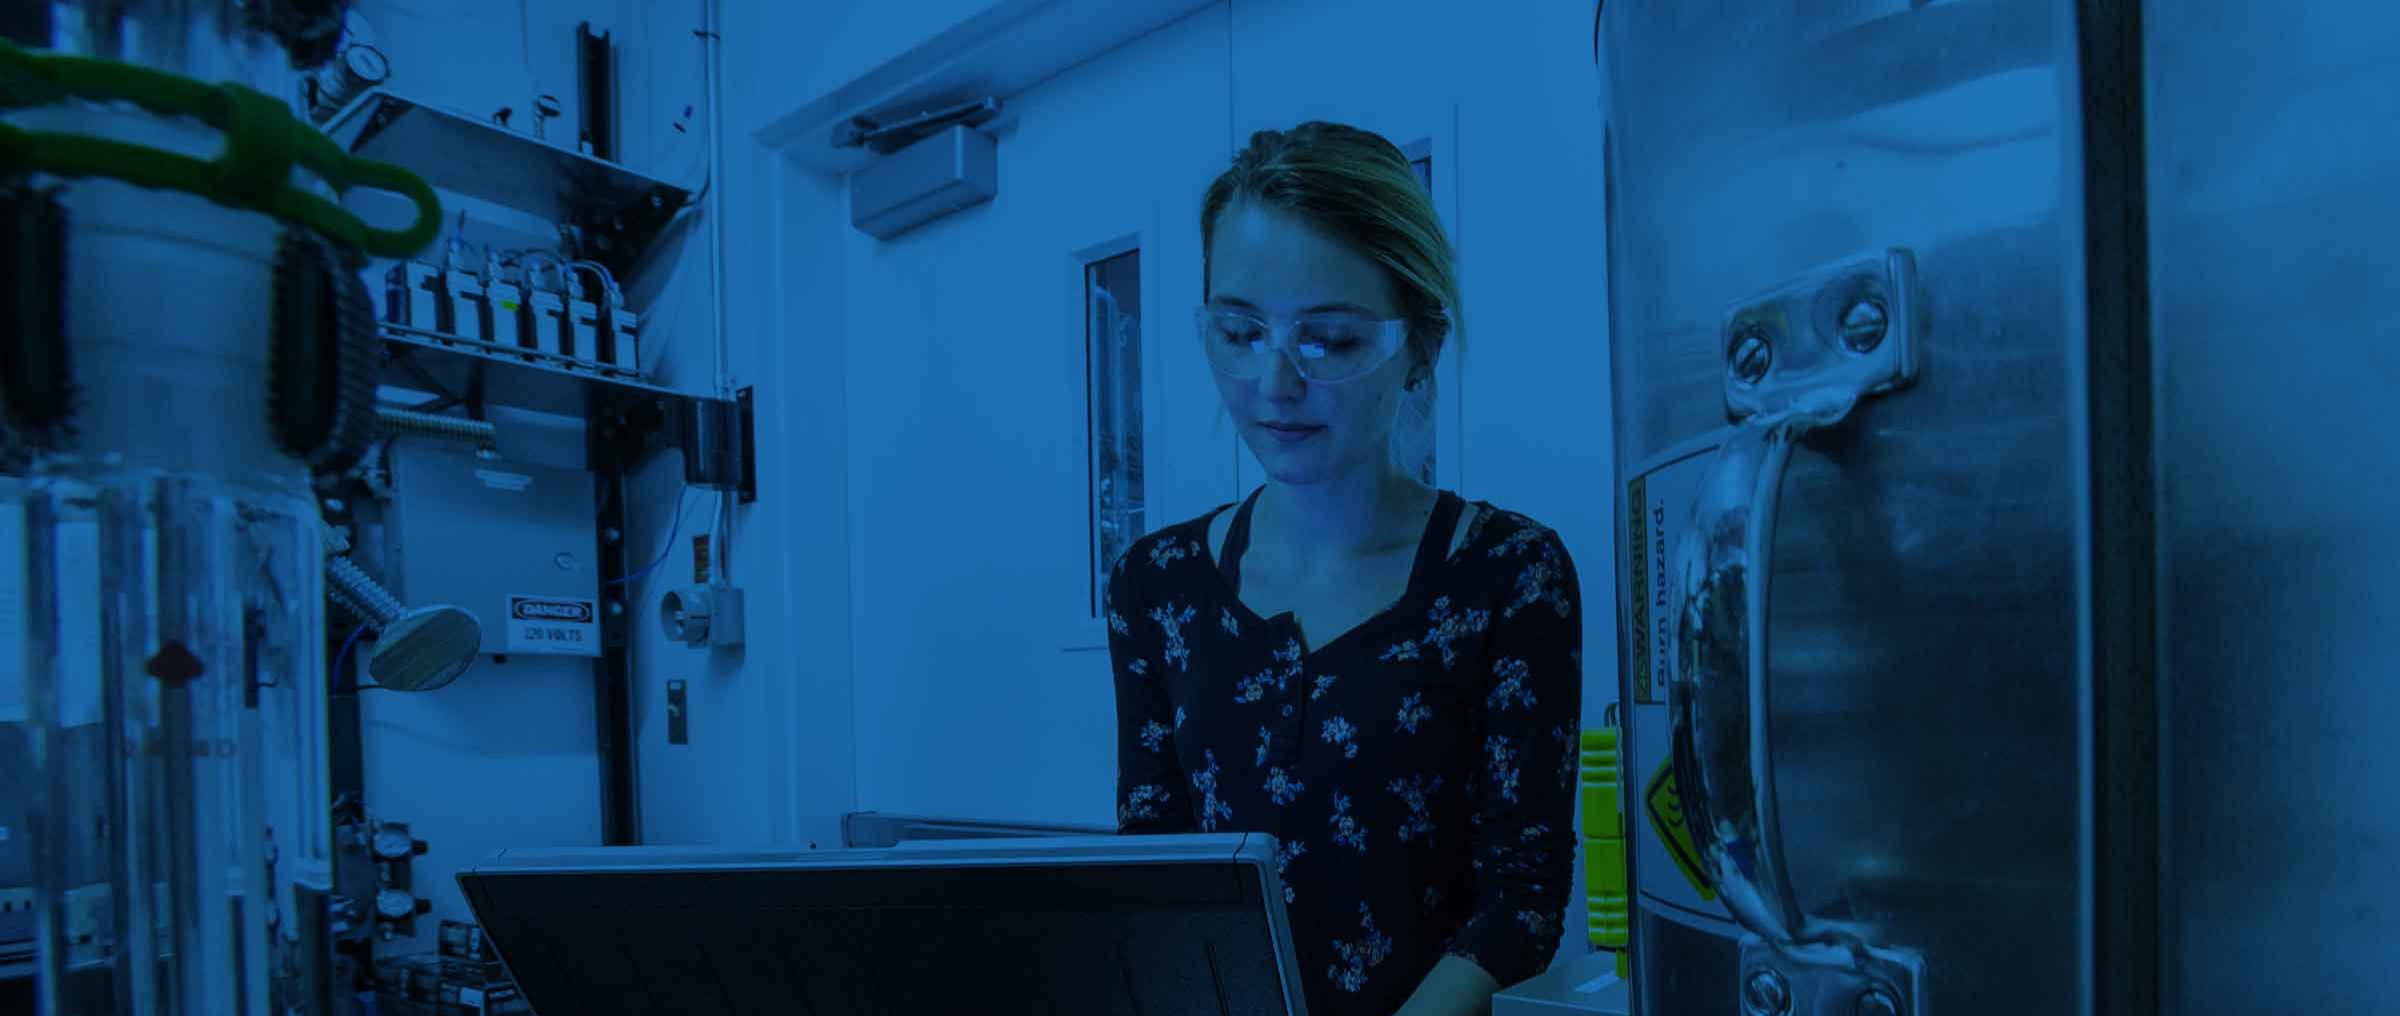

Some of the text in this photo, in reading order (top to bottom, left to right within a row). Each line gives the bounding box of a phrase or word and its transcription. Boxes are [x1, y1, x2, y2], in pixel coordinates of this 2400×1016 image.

[1631, 489, 1645, 658] WARNING
[1653, 498, 1665, 607] hazard.
[523, 604, 582, 618] DANGER
[546, 628, 582, 642] VOLTS
